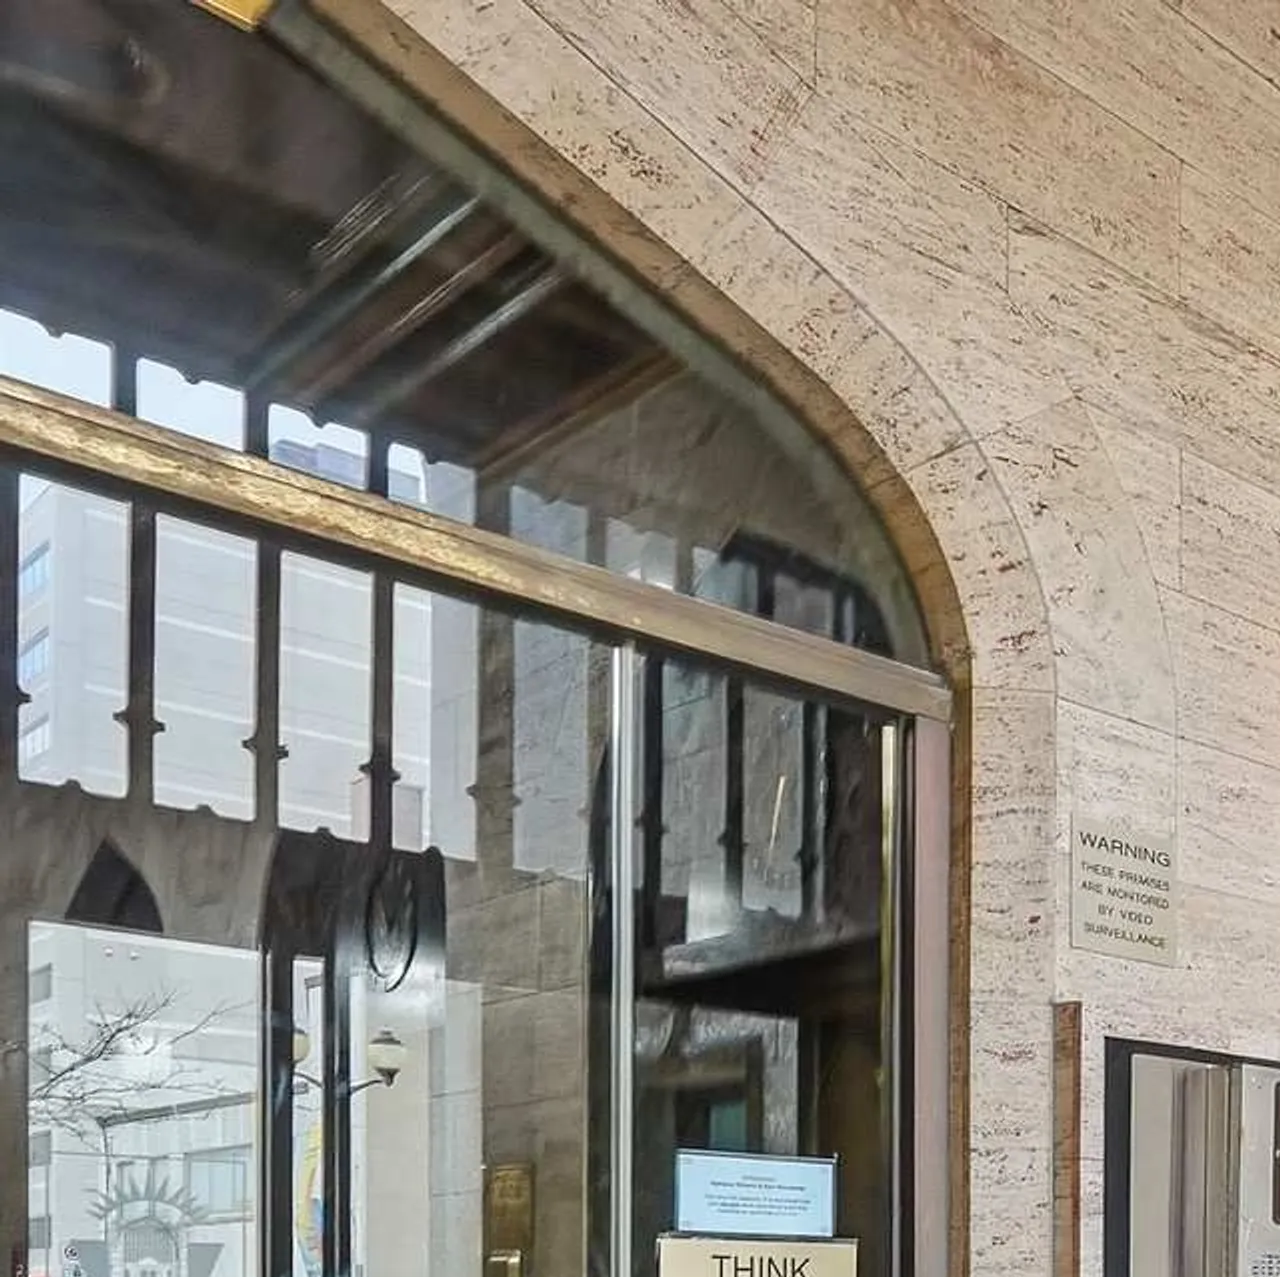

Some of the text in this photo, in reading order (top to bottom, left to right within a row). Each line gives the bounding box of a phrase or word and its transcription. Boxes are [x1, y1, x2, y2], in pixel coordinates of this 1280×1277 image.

[1079, 831, 1171, 868] WARNING
[1081, 861, 1170, 892] THESE PREMISES
[1081, 880, 1170, 910] ARE MONITORED
[1098, 903, 1154, 926] BY VIDEO
[1084, 921, 1167, 948] SURVEILLANCE
